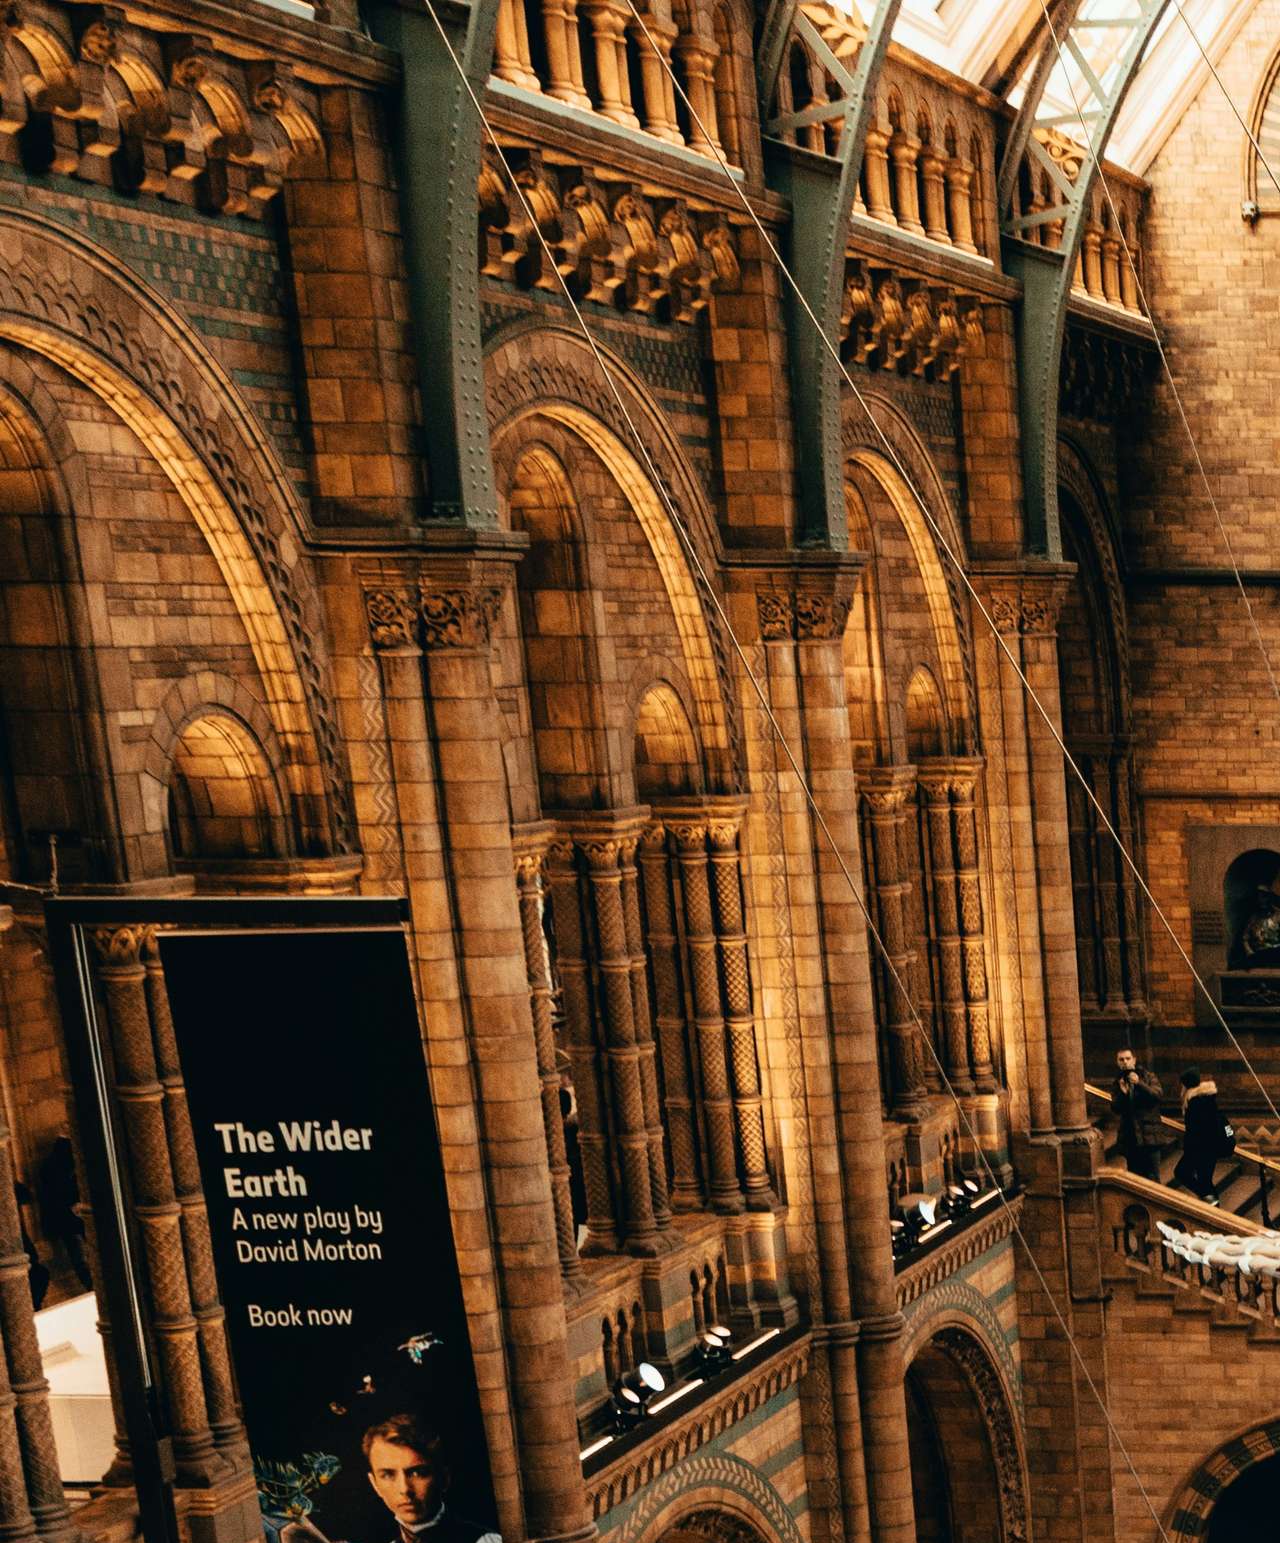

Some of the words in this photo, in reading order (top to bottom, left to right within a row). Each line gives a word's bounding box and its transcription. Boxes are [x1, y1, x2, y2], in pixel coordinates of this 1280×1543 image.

[214, 1122, 275, 1153] The
[279, 1120, 372, 1152] Wider
[224, 1166, 307, 1197] Earth
[233, 1208, 248, 1230] A
[252, 1213, 297, 1229] new
[304, 1206, 351, 1235] play
[355, 1205, 382, 1234] by
[237, 1239, 298, 1262] David
[303, 1239, 381, 1261] Morton
[248, 1304, 303, 1326] Book
[307, 1309, 352, 1325] now
